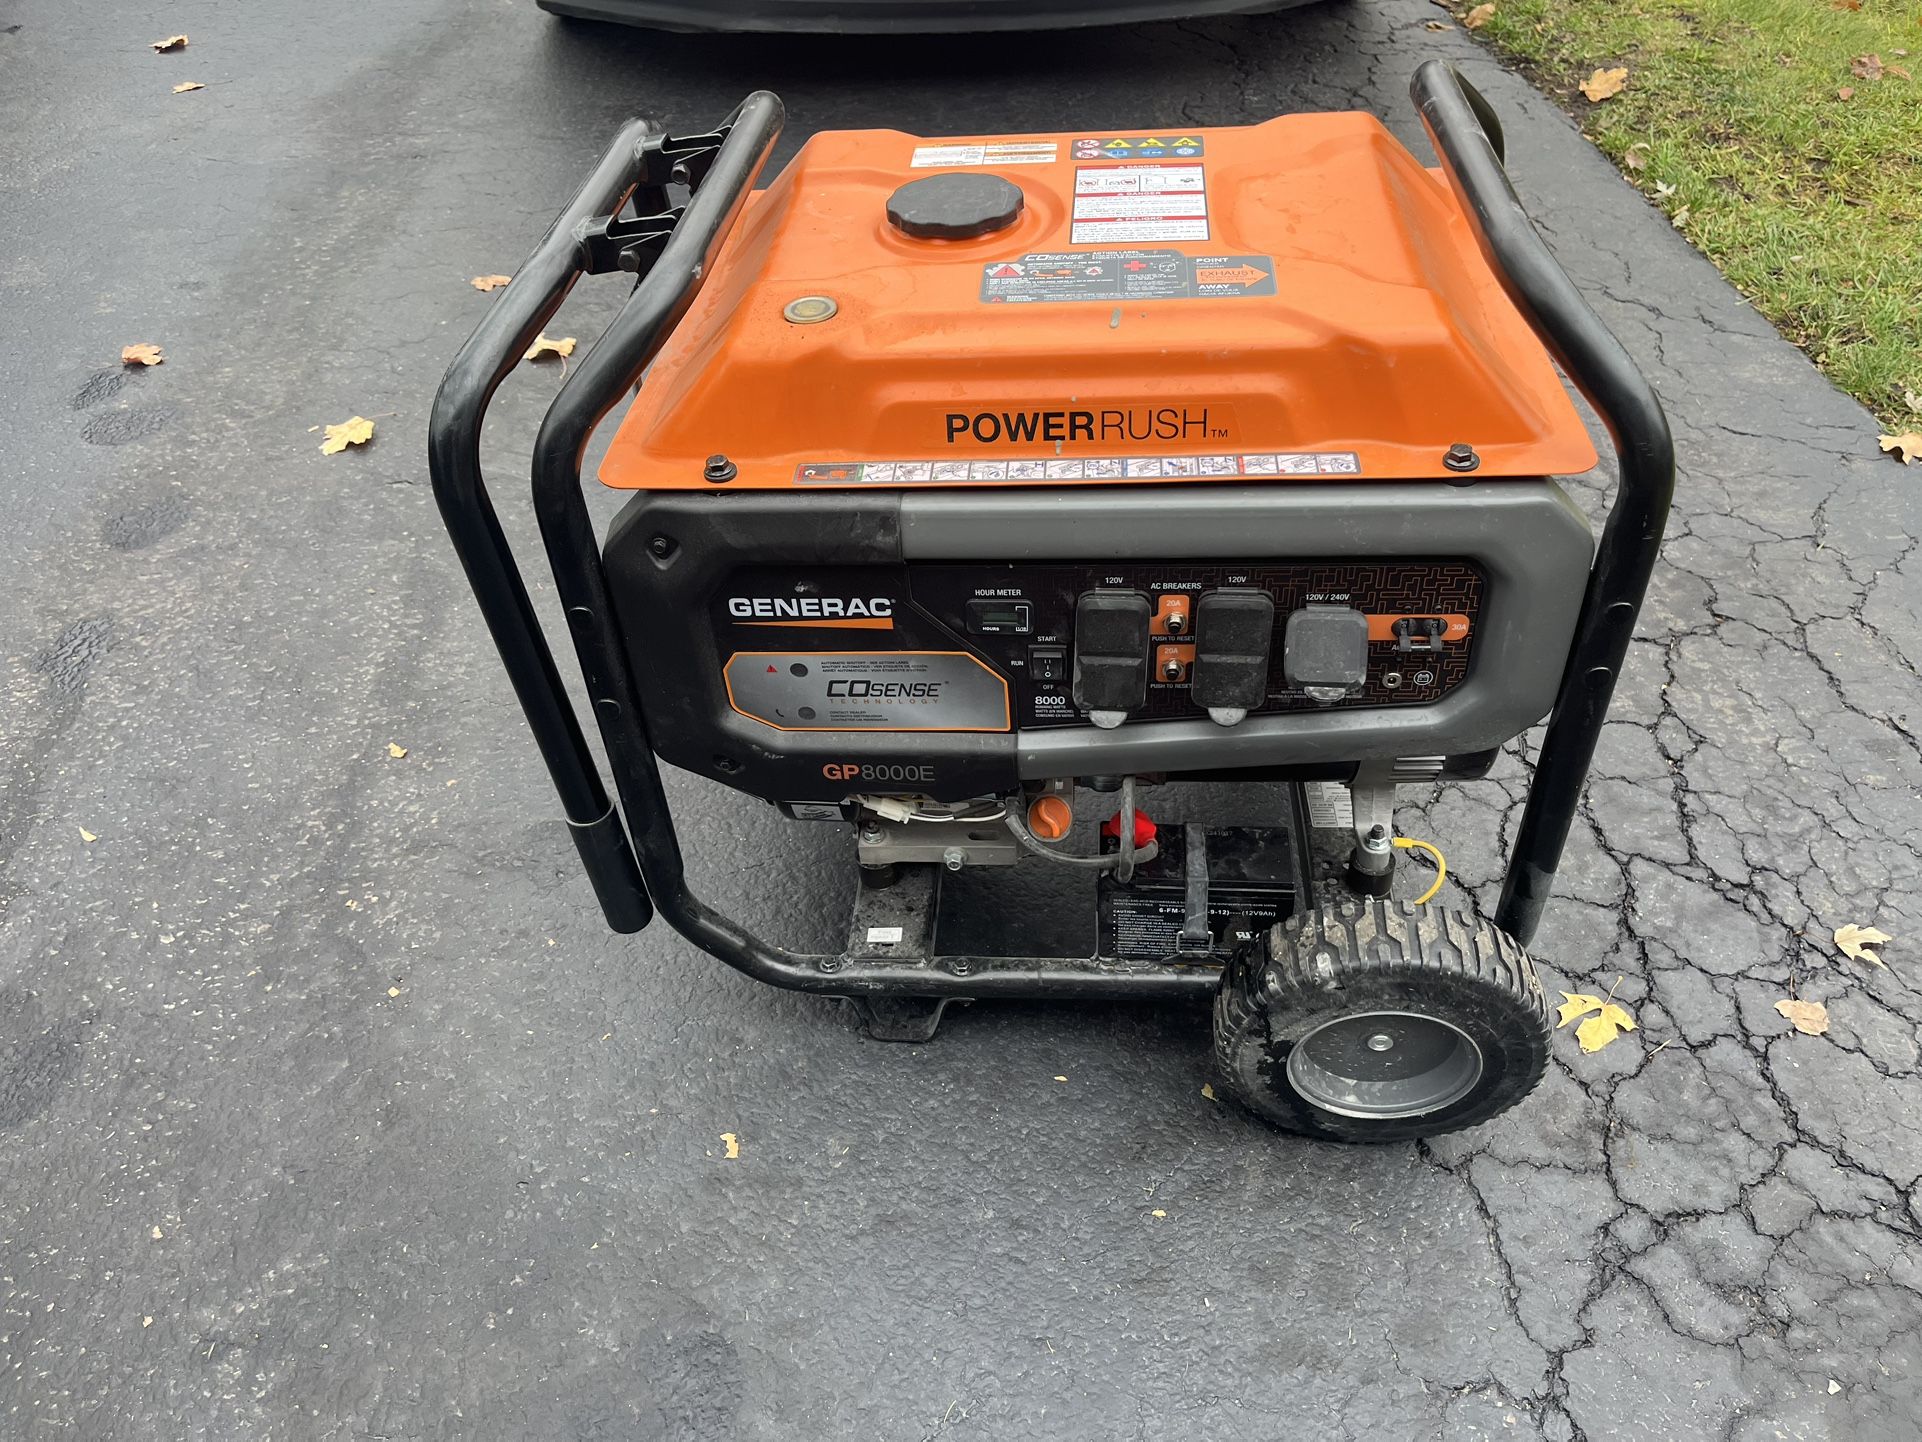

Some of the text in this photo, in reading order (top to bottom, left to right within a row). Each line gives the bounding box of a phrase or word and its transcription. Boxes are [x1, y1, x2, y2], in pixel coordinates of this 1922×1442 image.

[1228, 575, 1247, 583] 120V
[1162, 582, 1202, 590] BREAKERS
[974, 588, 1022, 596] HOUR METER
[1306, 593, 1324, 601] 120V
[1330, 593, 1350, 601] 240V
[728, 597, 892, 617] GENERAC
[1451, 623, 1467, 631] 30A
[1034, 695, 1066, 705] 8000
[822, 763, 936, 781] GP8000E
